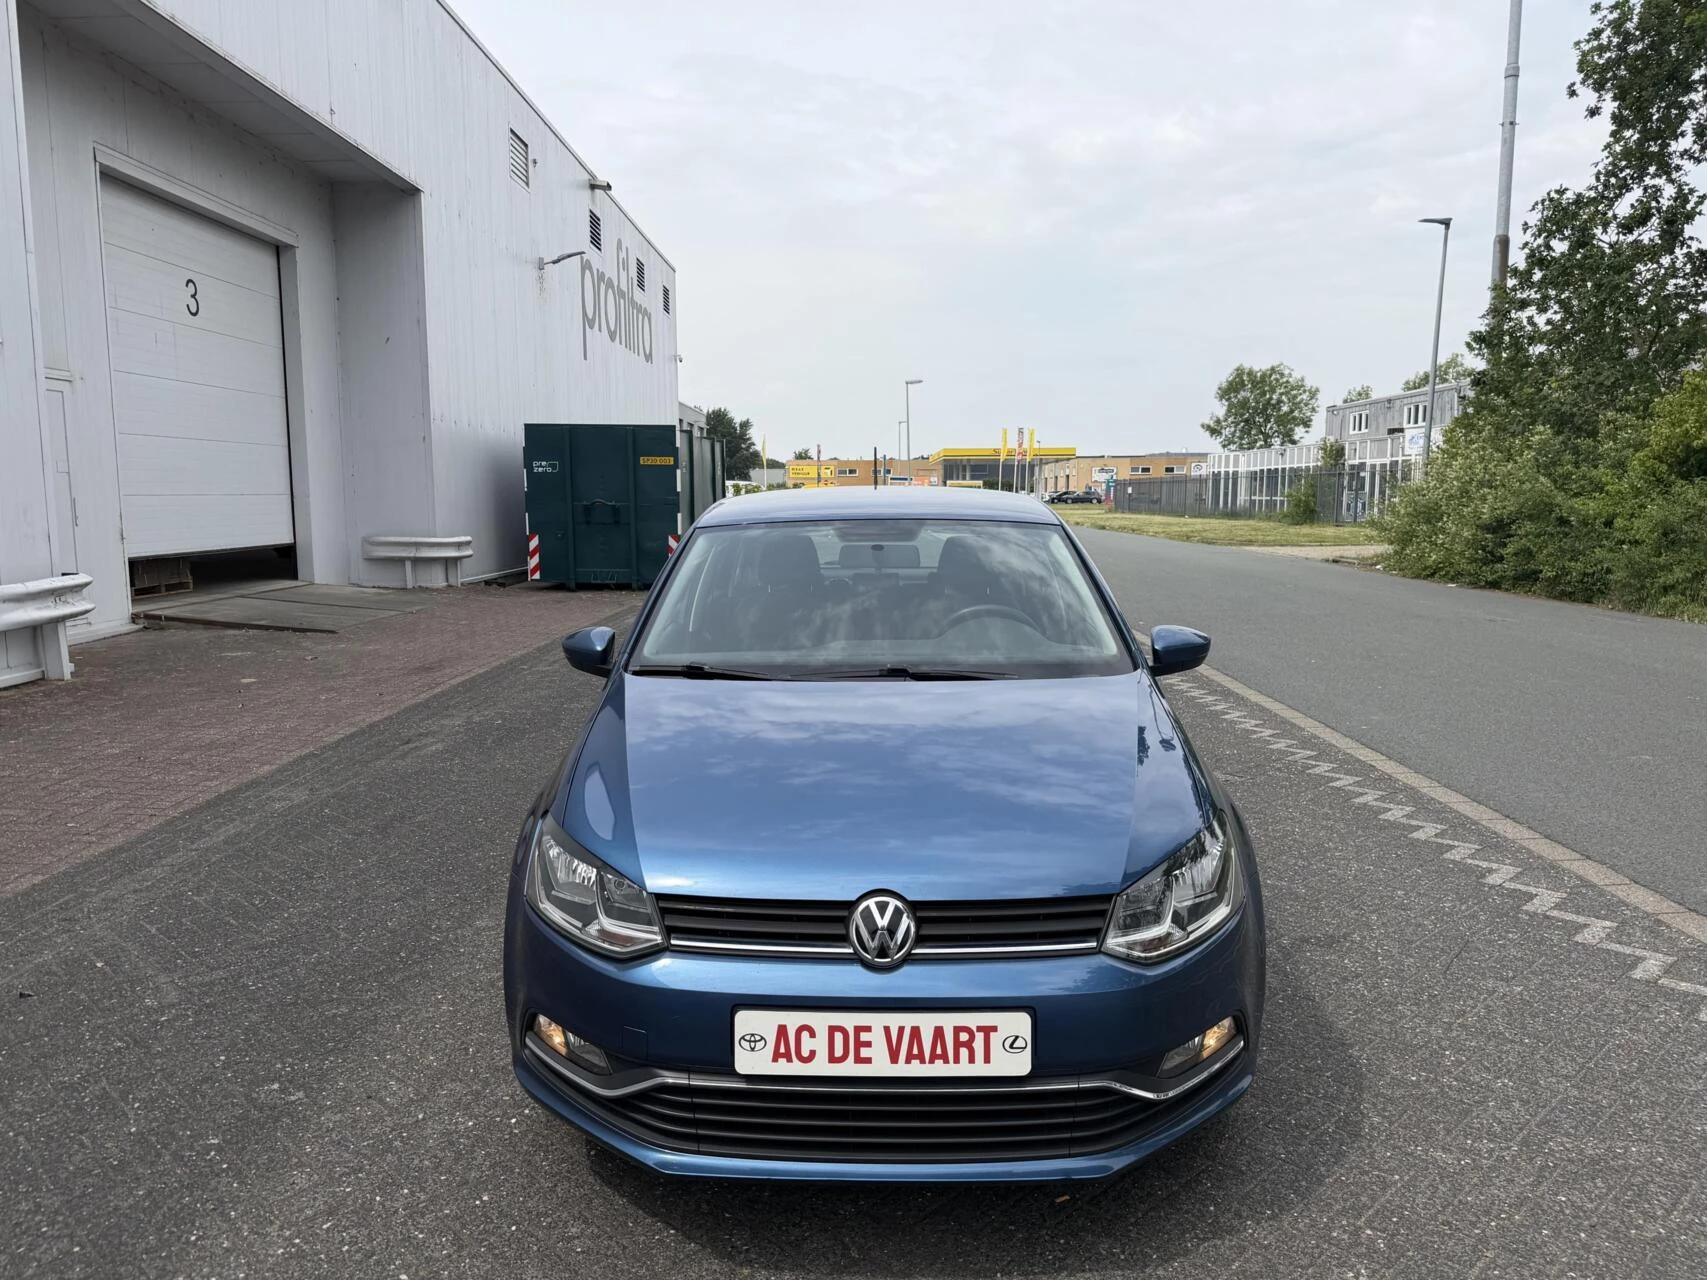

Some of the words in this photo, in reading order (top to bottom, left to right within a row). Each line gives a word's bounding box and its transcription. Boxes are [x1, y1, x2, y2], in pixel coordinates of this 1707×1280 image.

[185, 278, 200, 317] 3
[580, 238, 653, 364] profiltra
[771, 1023, 817, 1064] AC
[827, 1025, 873, 1065] DE
[883, 1025, 998, 1065] VAART
